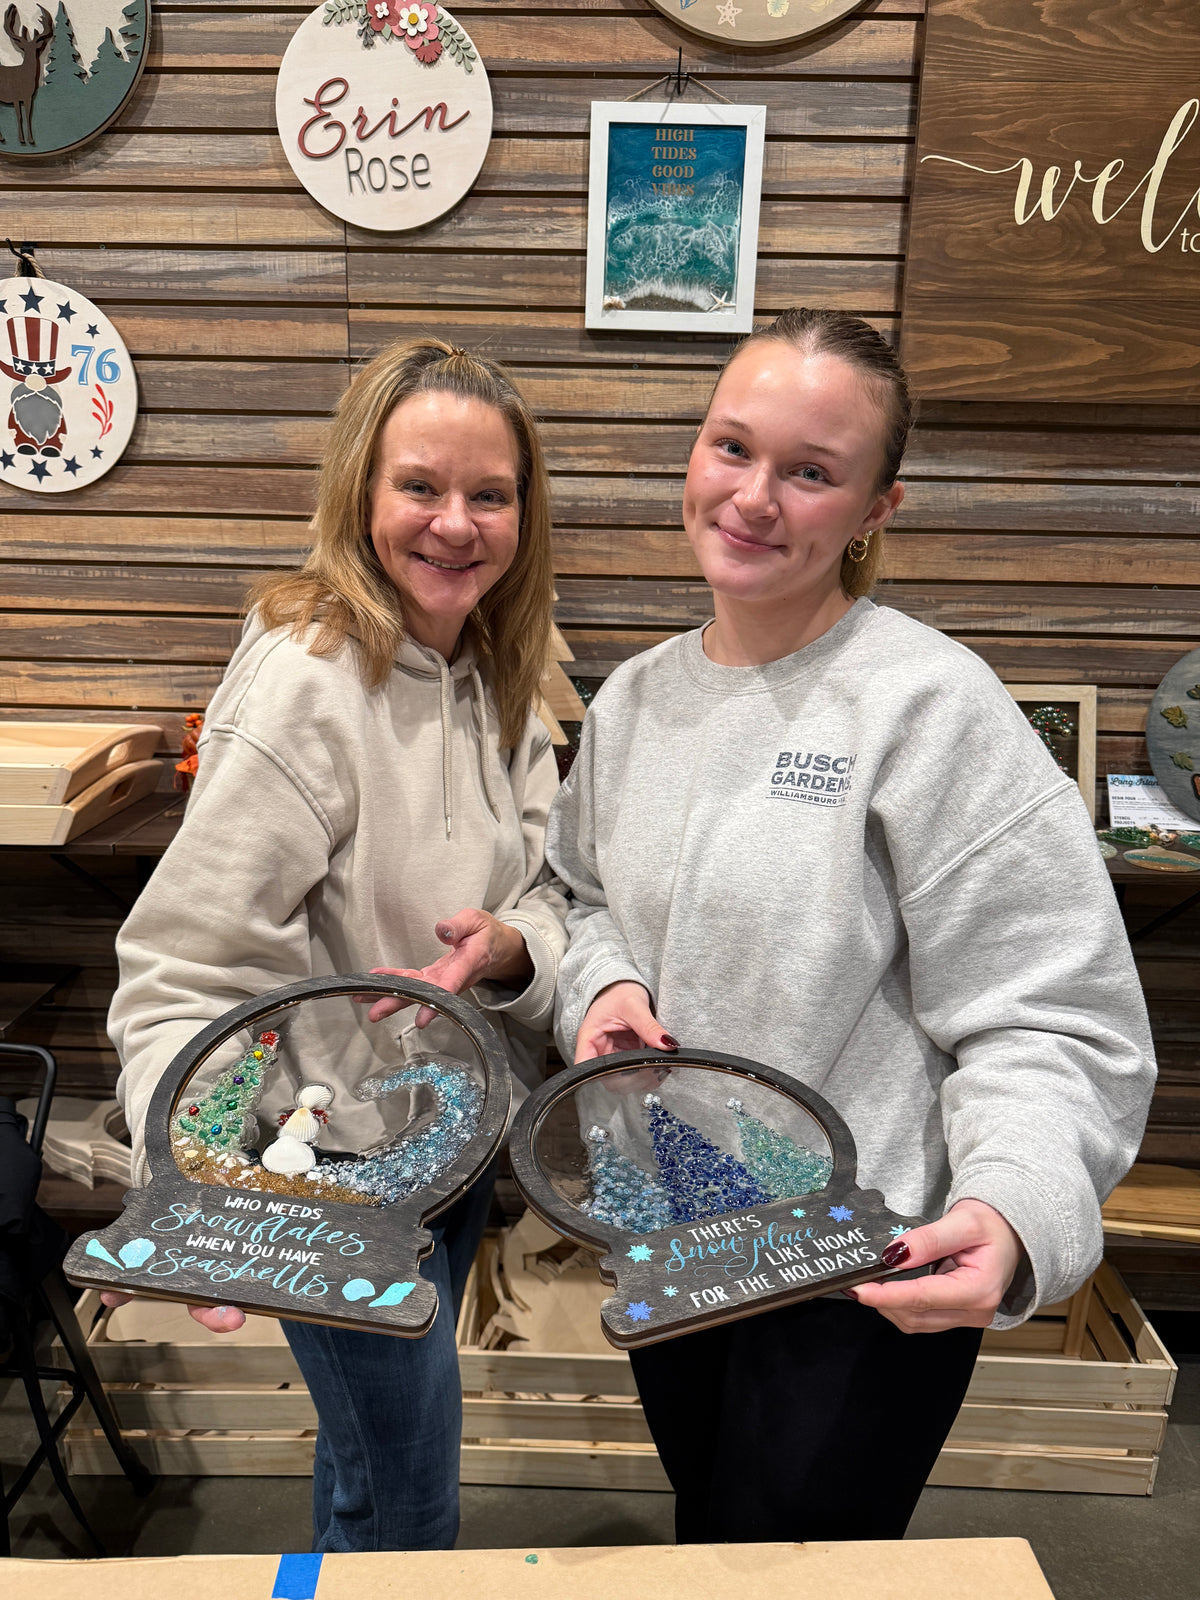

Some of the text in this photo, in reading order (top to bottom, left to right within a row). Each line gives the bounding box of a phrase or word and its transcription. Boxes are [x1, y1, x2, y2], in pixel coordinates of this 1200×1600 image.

[298, 77, 470, 158] Erin
[655, 128, 694, 141] HIGH
[345, 147, 431, 194] Rose
[651, 146, 697, 160] TIDES
[651, 182, 695, 196] VIBES
[652, 165, 694, 178] GOOD
[921, 98, 1200, 253] wel
[71, 344, 121, 386] 76
[775, 752, 858, 774] BUSCH
[770, 789, 837, 804] WILLIAMSBURG
[224, 1195, 324, 1220] WHO NEEDS
[151, 1203, 374, 1256] Snowflakes
[687, 1214, 762, 1243] THERE'S
[186, 1234, 324, 1266] WHEN YOU HAVE
[664, 1221, 819, 1278] Snow place
[765, 1227, 871, 1266] LIKE HOME
[147, 1248, 337, 1297] Seashells
[689, 1246, 877, 1308] FOR THE HOLIDAYS
